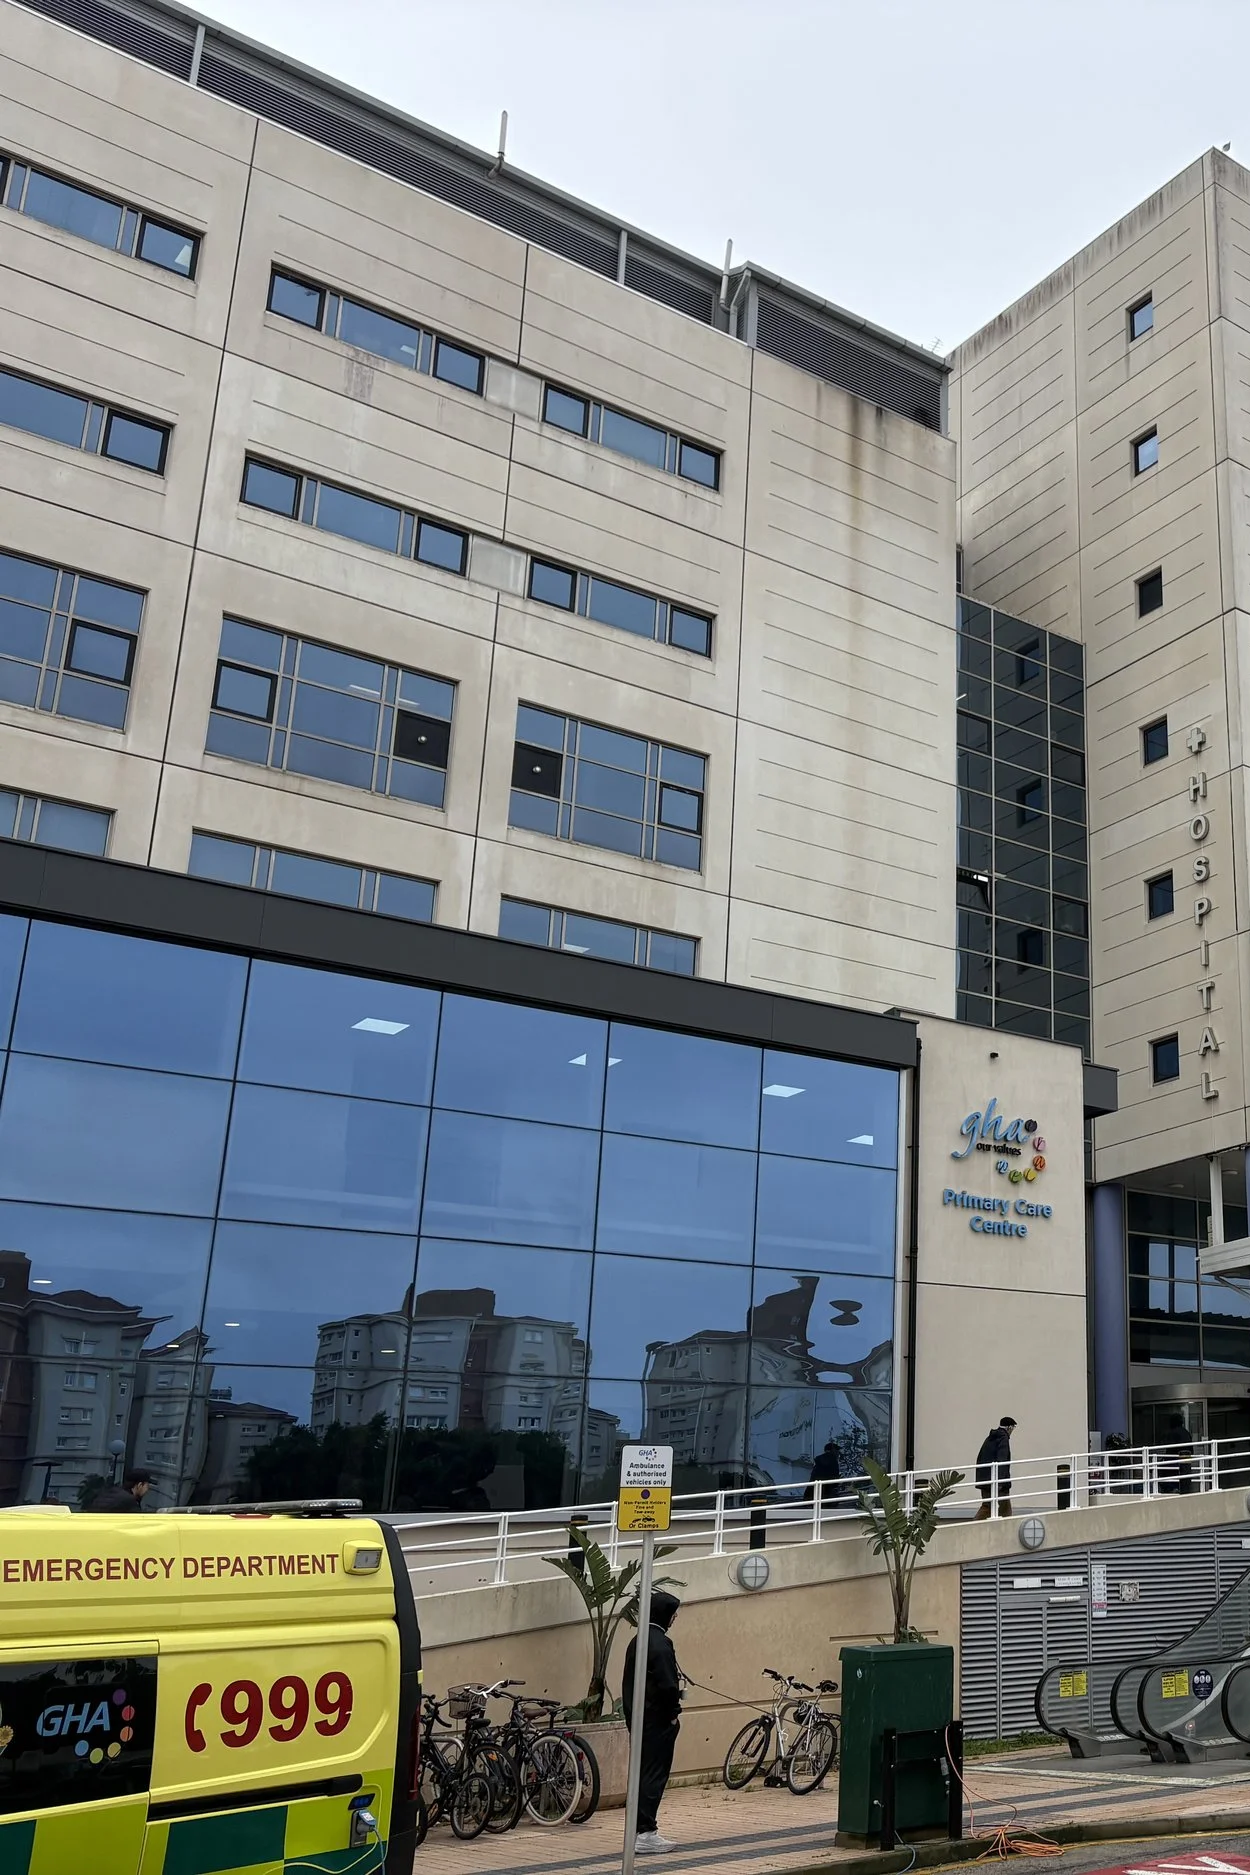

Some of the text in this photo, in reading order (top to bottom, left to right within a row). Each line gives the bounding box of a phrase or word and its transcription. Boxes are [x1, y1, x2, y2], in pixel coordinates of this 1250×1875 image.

[1188, 771, 1219, 1101] HOSPITAL
[951, 1098, 1032, 1160] gha
[976, 1143, 1022, 1157] our values
[943, 1188, 1053, 1218] Primary Care
[970, 1215, 1028, 1238] Centre
[2, 1553, 340, 1583] EMERGENCY DEPARTMENT
[36, 1700, 111, 1737] GHA
[220, 1671, 354, 1748] 999
